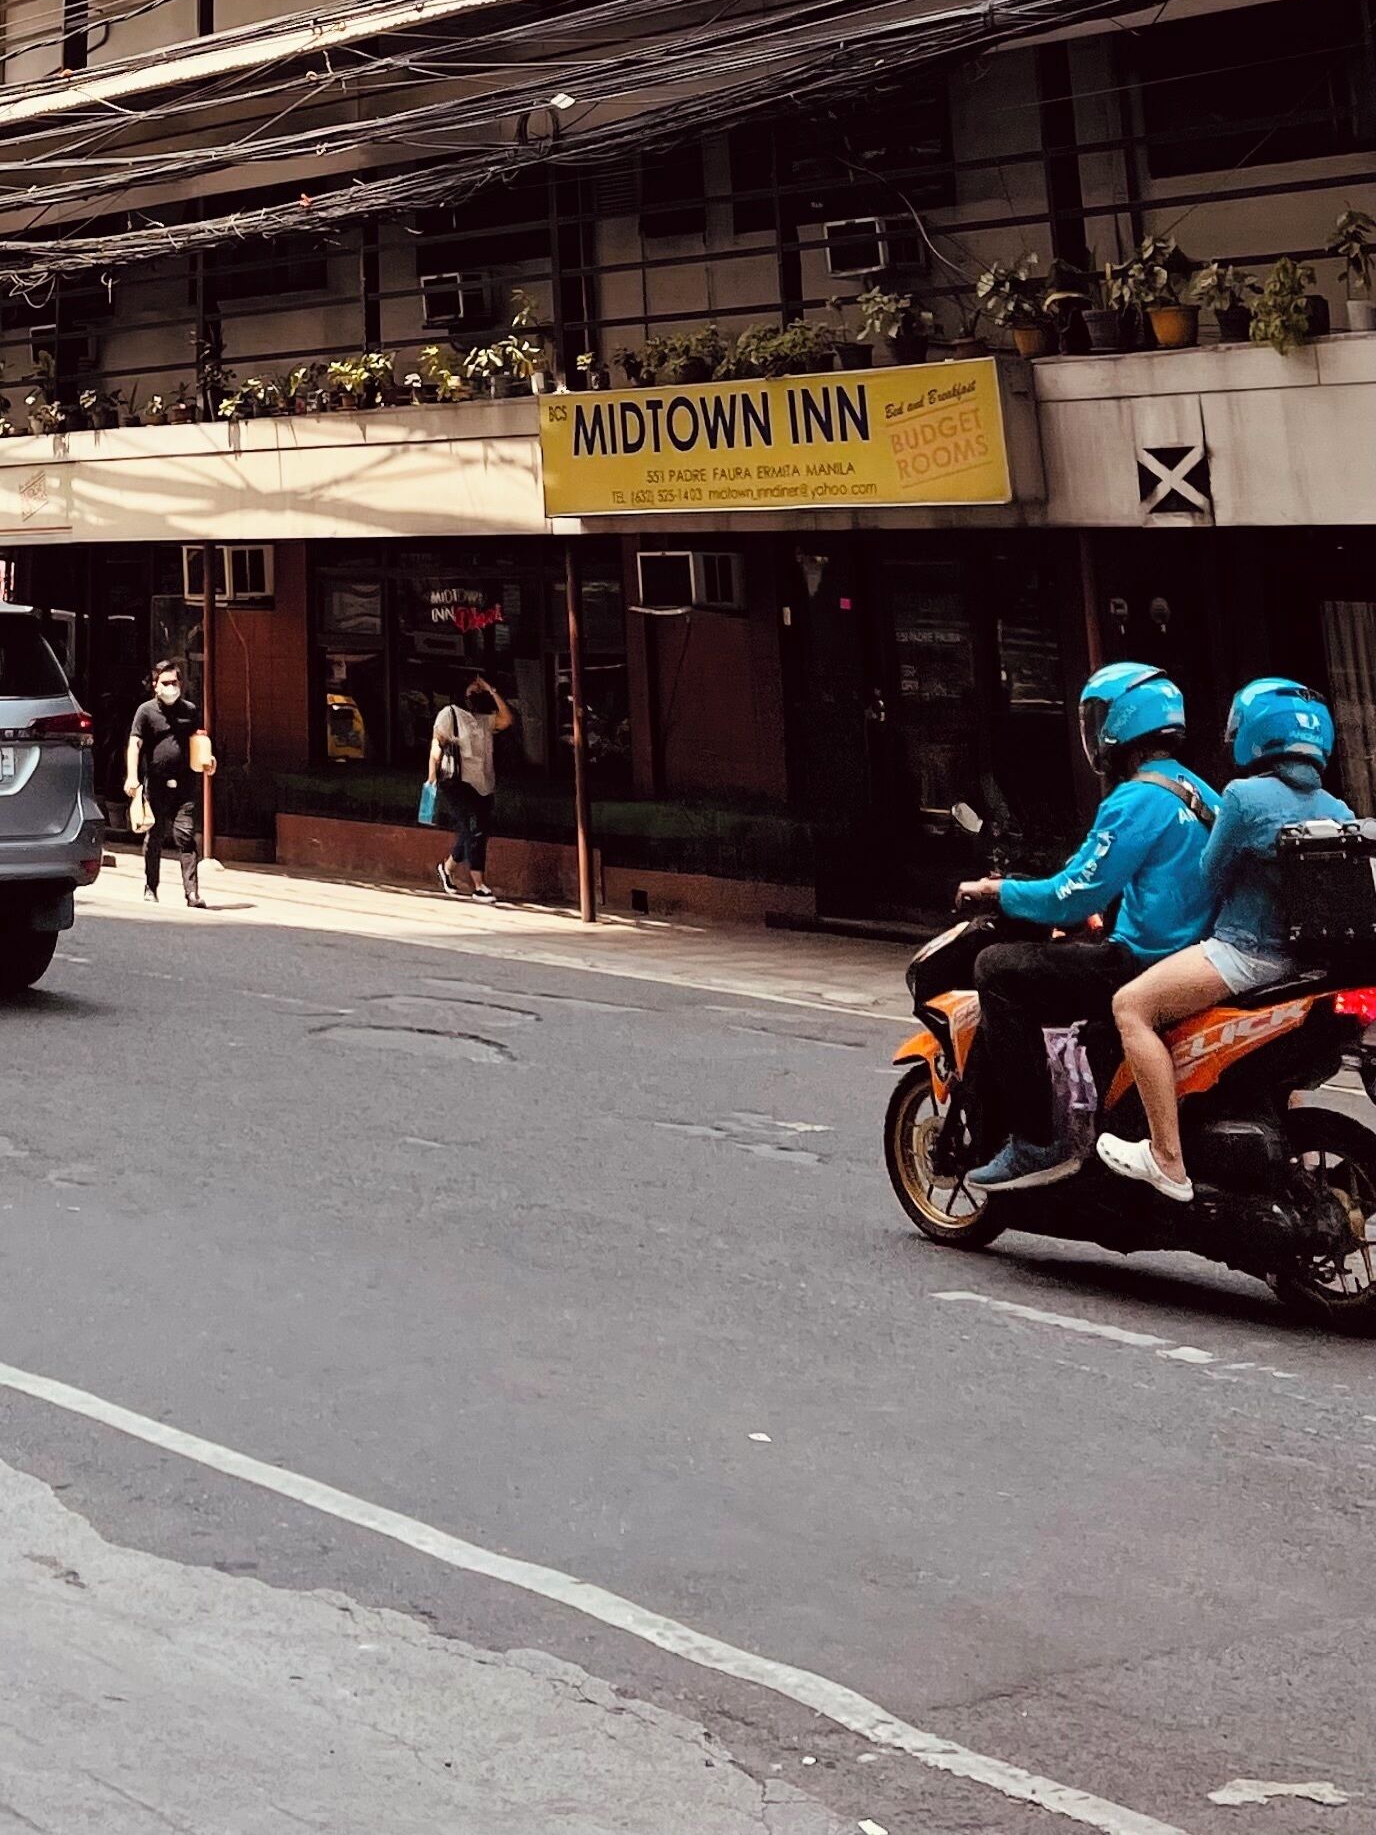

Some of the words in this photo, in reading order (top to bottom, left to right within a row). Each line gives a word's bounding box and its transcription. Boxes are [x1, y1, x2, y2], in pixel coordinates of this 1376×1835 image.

[573, 391, 773, 457] MIDTOWN
[787, 384, 870, 445] INN
[884, 403, 903, 420] Bed
[906, 395, 925, 413] and
[927, 379, 977, 406] Breakfast
[889, 407, 984, 455] BUDGET
[668, 468, 707, 483] PADRE
[712, 466, 753, 481] FAURA
[756, 464, 801, 480] ERMITA
[805, 461, 856, 477] MANILA
[895, 434, 990, 481] ROOMS
[430, 588, 484, 604] MIDTW
